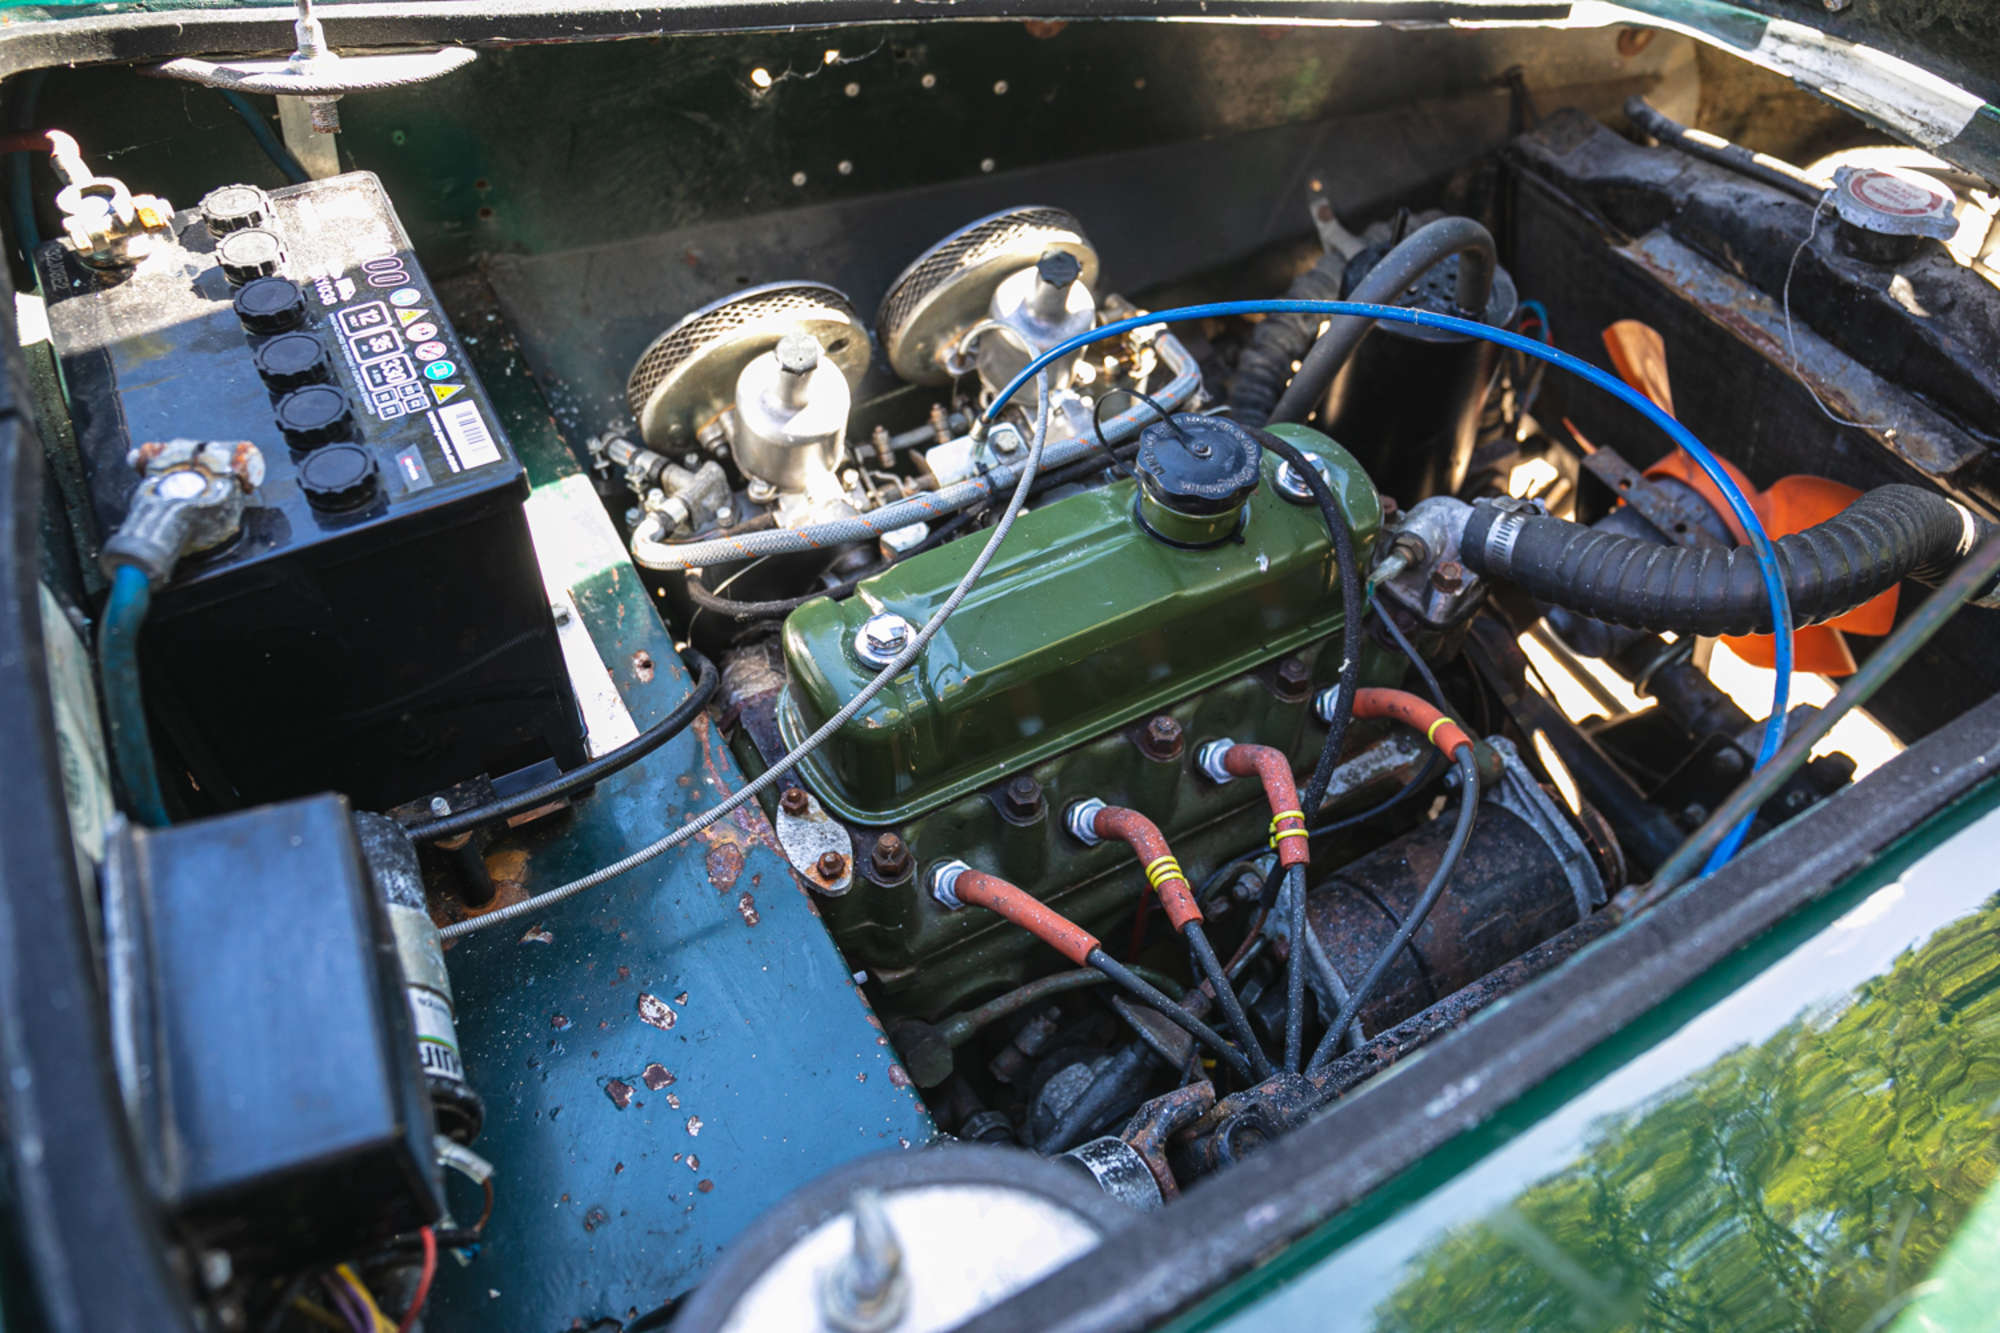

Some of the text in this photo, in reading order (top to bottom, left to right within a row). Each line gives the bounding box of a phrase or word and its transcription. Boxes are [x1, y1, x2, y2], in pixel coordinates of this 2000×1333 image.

[358, 308, 380, 326] 12
[368, 334, 393, 354] 35
[378, 358, 407, 385] 330
